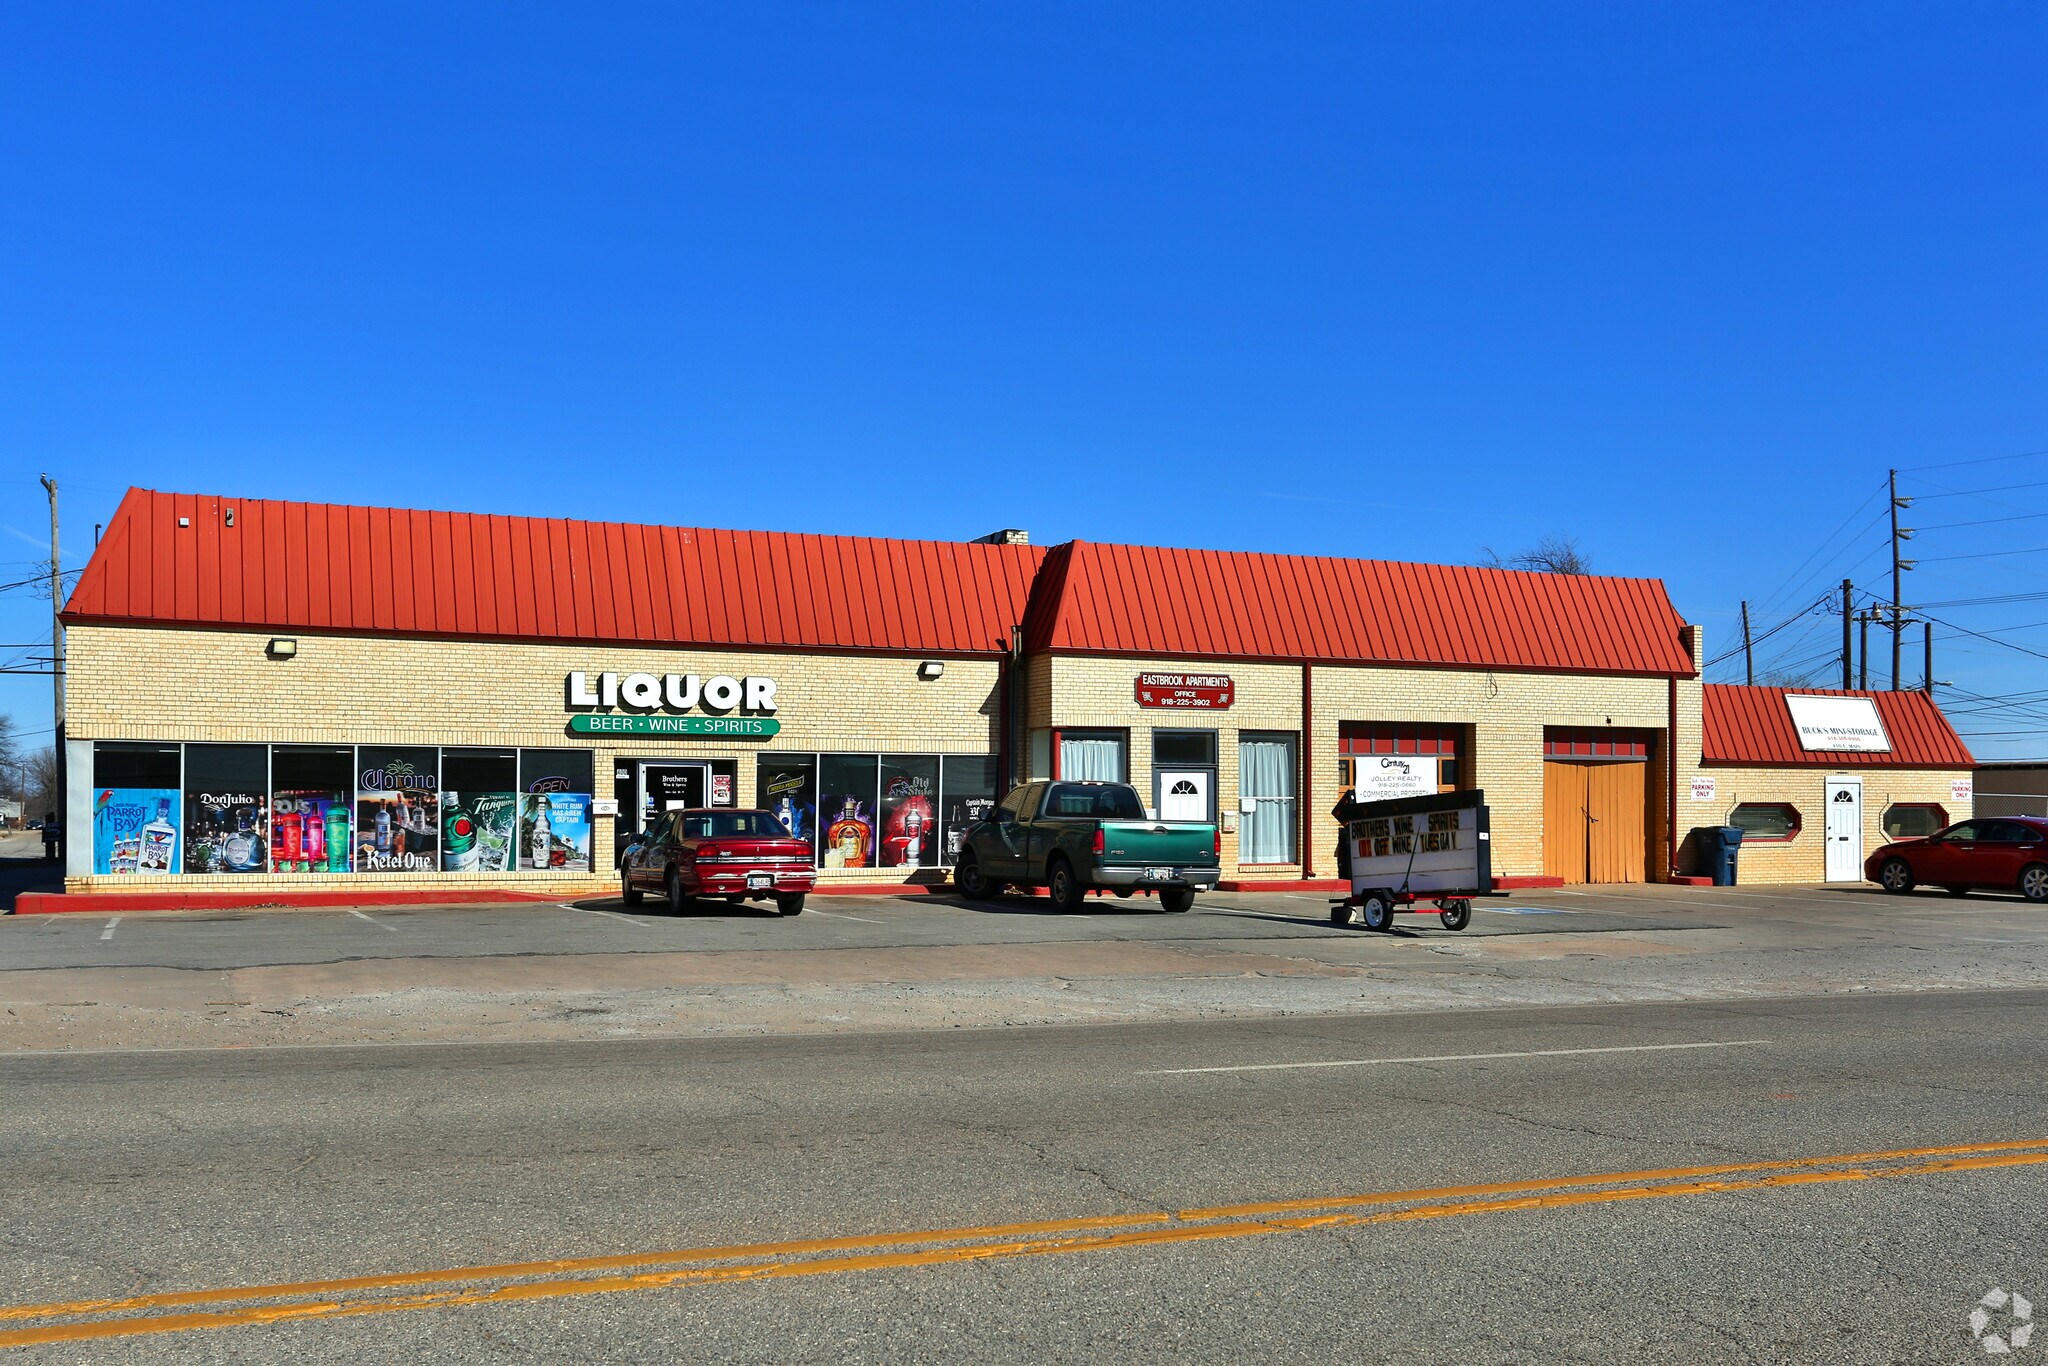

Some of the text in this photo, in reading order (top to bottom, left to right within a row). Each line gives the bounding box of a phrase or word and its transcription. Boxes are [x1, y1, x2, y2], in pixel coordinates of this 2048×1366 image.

[1142, 674, 1229, 688] EASTBROOK APARTMENTS
[566, 671, 779, 714] LIQUOR
[1161, 698, 1211, 707] 918-225-3902
[590, 717, 762, 733] BEER WINE SPIRITS
[1802, 726, 1829, 735] BUCK'S
[1380, 757, 1411, 775] Century 21
[360, 768, 436, 792] Corona
[532, 780, 570, 793] OPEN
[912, 776, 930, 789] Old
[1362, 790, 1399, 798] COMMERCIAL
[106, 806, 149, 822] PARROT
[552, 809, 565, 817] HAS
[114, 817, 141, 832] BAY
[1352, 811, 1459, 840] BROTHERS WINE SPIRITS
[1392, 836, 1412, 854] WINE
[1420, 831, 1457, 853] TUESDAY
[366, 850, 431, 870] Ketel One
